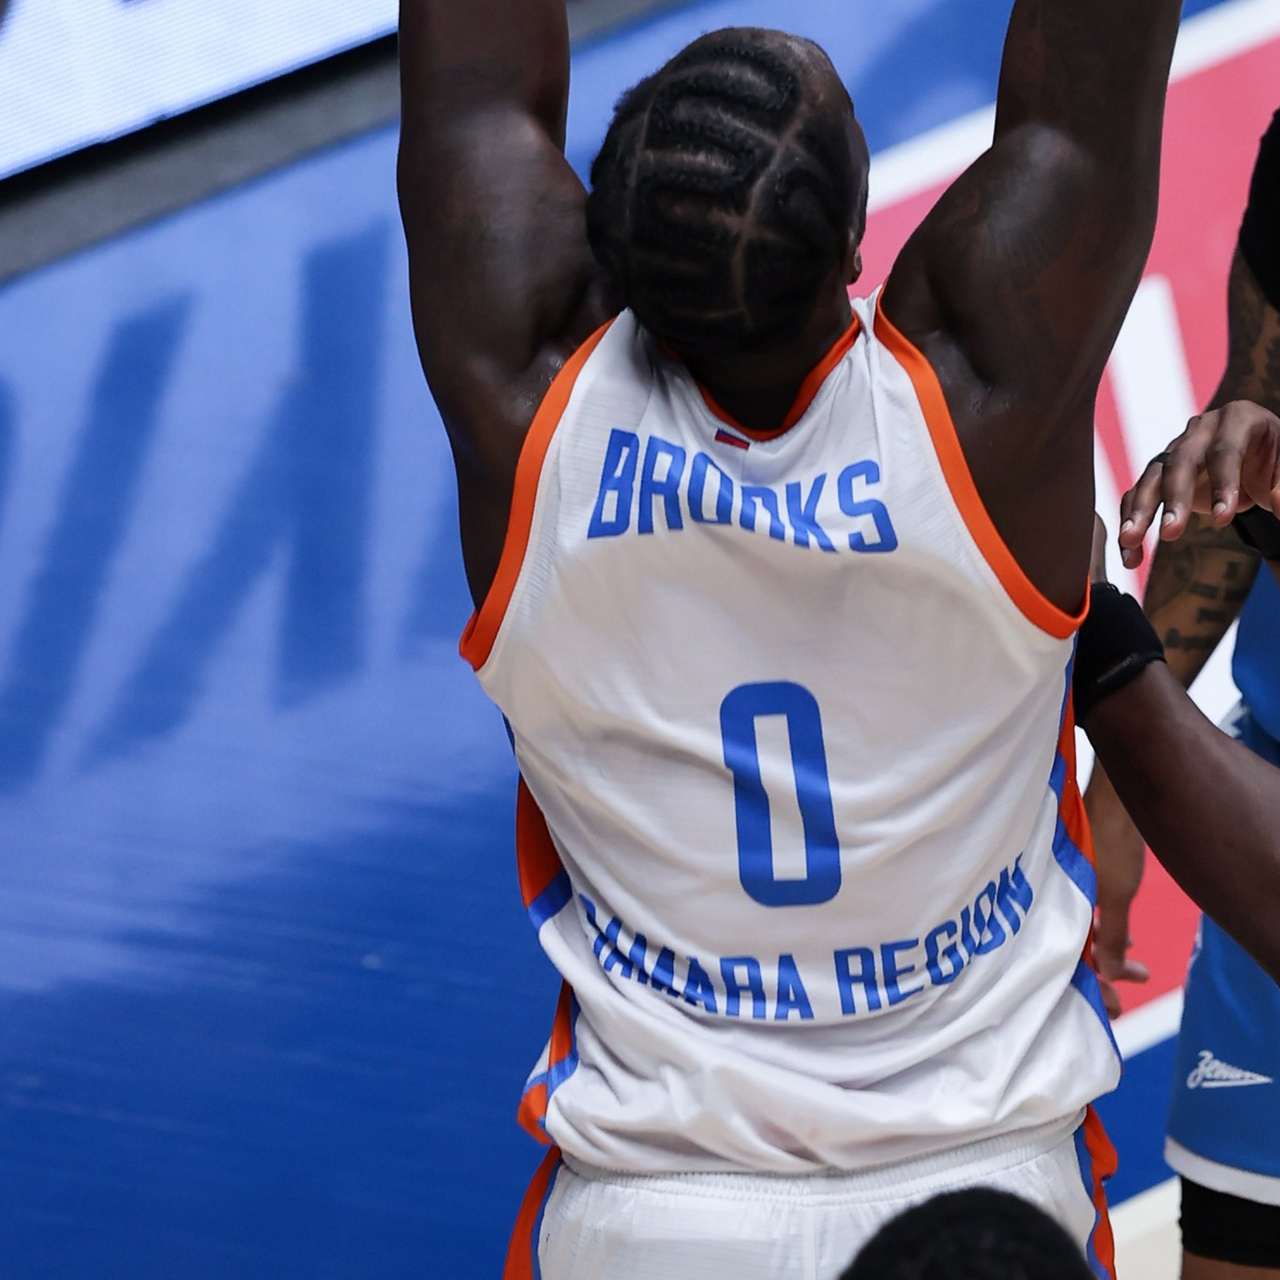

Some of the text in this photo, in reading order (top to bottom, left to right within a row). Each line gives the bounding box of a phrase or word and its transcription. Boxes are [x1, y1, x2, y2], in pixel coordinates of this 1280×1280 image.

[587, 428, 899, 554] BROOKS
[719, 680, 842, 908] 0
[832, 851, 1035, 1016] REGION
